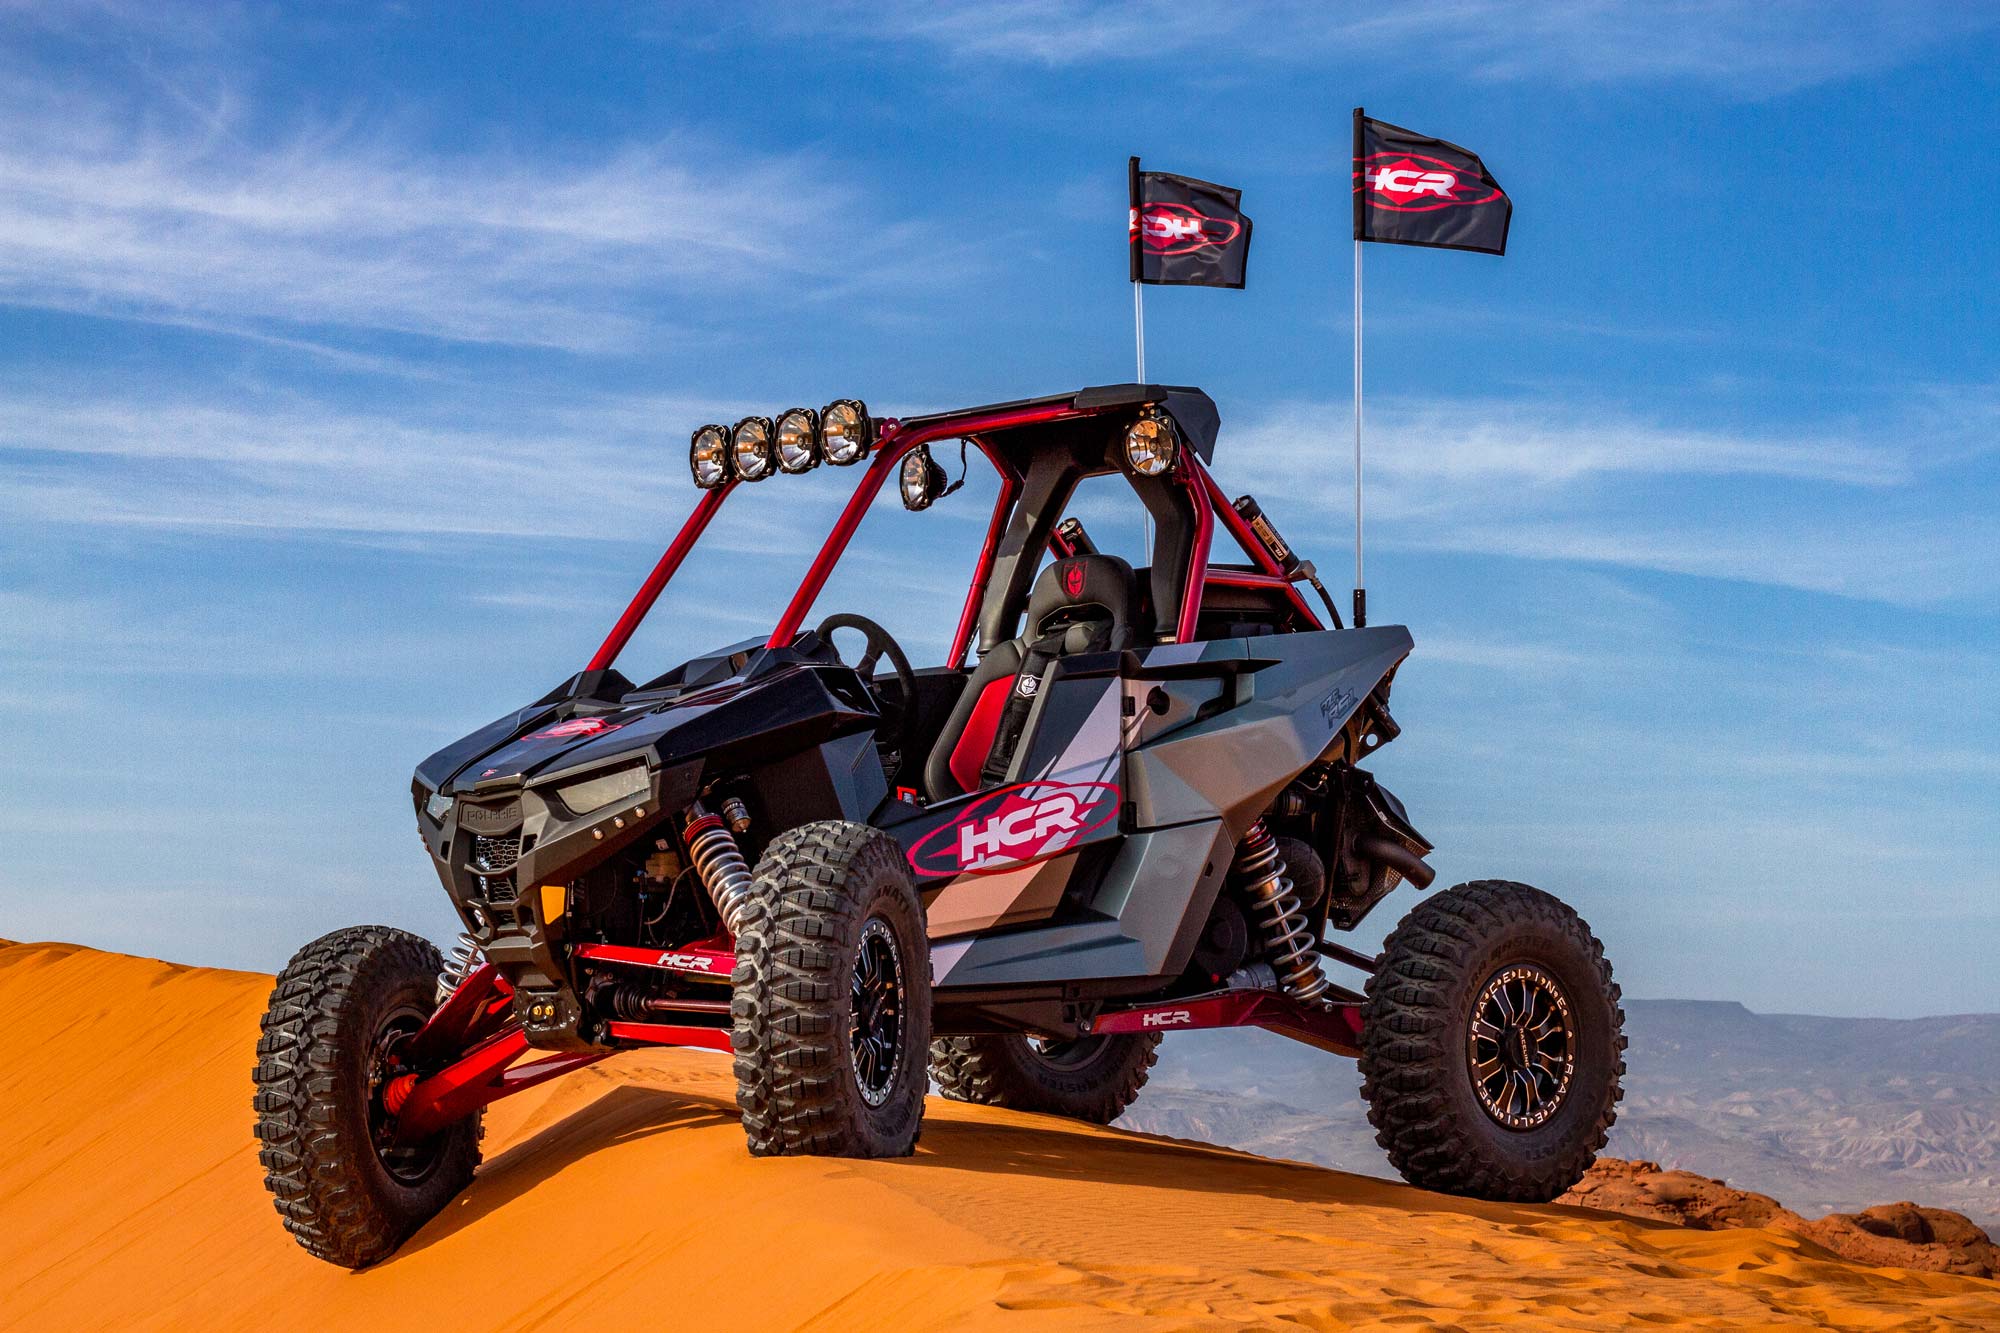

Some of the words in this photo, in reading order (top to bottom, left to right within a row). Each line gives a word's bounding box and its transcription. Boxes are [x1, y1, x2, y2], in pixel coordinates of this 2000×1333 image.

[1365, 167, 1453, 197] HCR
[961, 796, 1080, 862] HCR
[657, 952, 713, 970] HCR
[1143, 1010, 1191, 1026] HCR
[1472, 969, 1567, 1033] RACELINE
[1519, 1027, 1531, 1069] RACELINE
[1480, 1064, 1574, 1127] RACELINE
